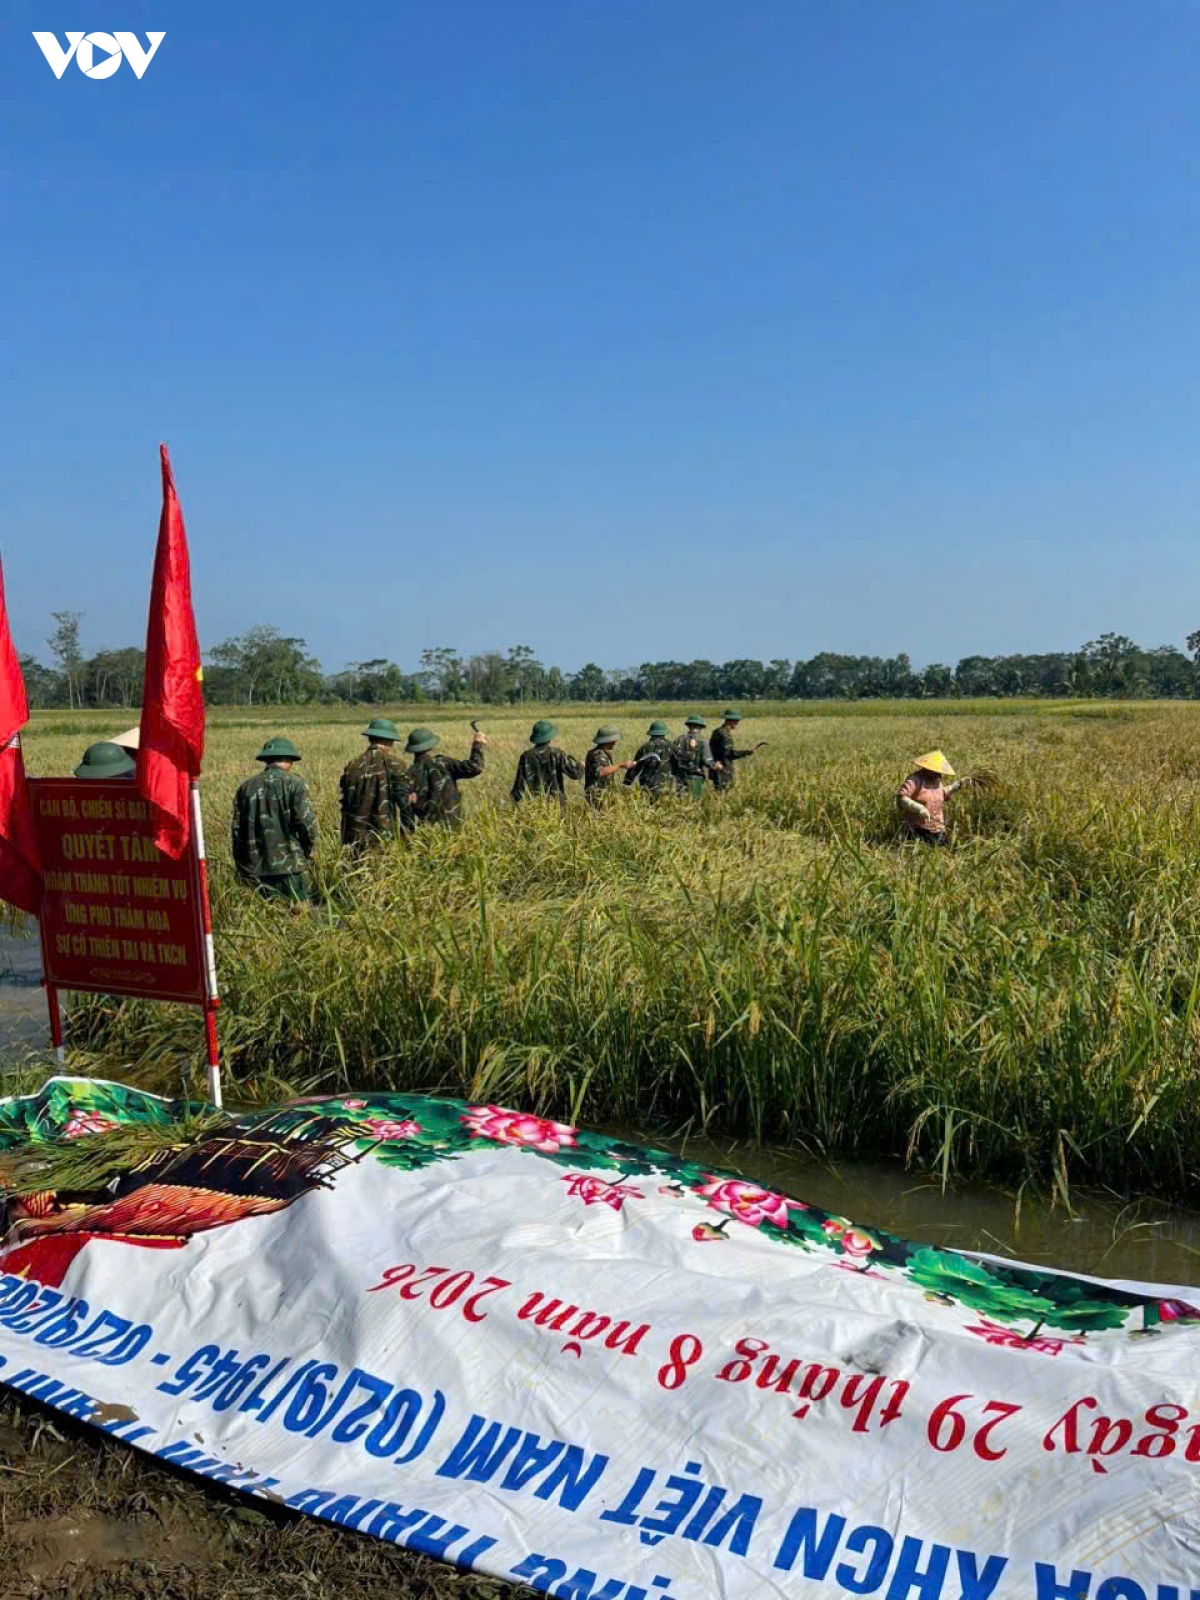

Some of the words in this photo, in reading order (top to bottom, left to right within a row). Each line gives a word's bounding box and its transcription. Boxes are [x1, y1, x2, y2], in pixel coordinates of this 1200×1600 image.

[61, 826, 116, 861] QUYẾT
[120, 831, 161, 863] TÂM
[172, 879, 188, 904] VỤ
[365, 1264, 512, 1322] 2026
[517, 1291, 651, 1359] năm
[658, 1334, 702, 1390] 8
[715, 1337, 910, 1432] tháng
[156, 1344, 446, 1465] (02/9/1945
[927, 1394, 1023, 1461] 29
[435, 1414, 610, 1512] NAM
[600, 1461, 764, 1557] VIỆT
[773, 1507, 1009, 1600] XHCN
